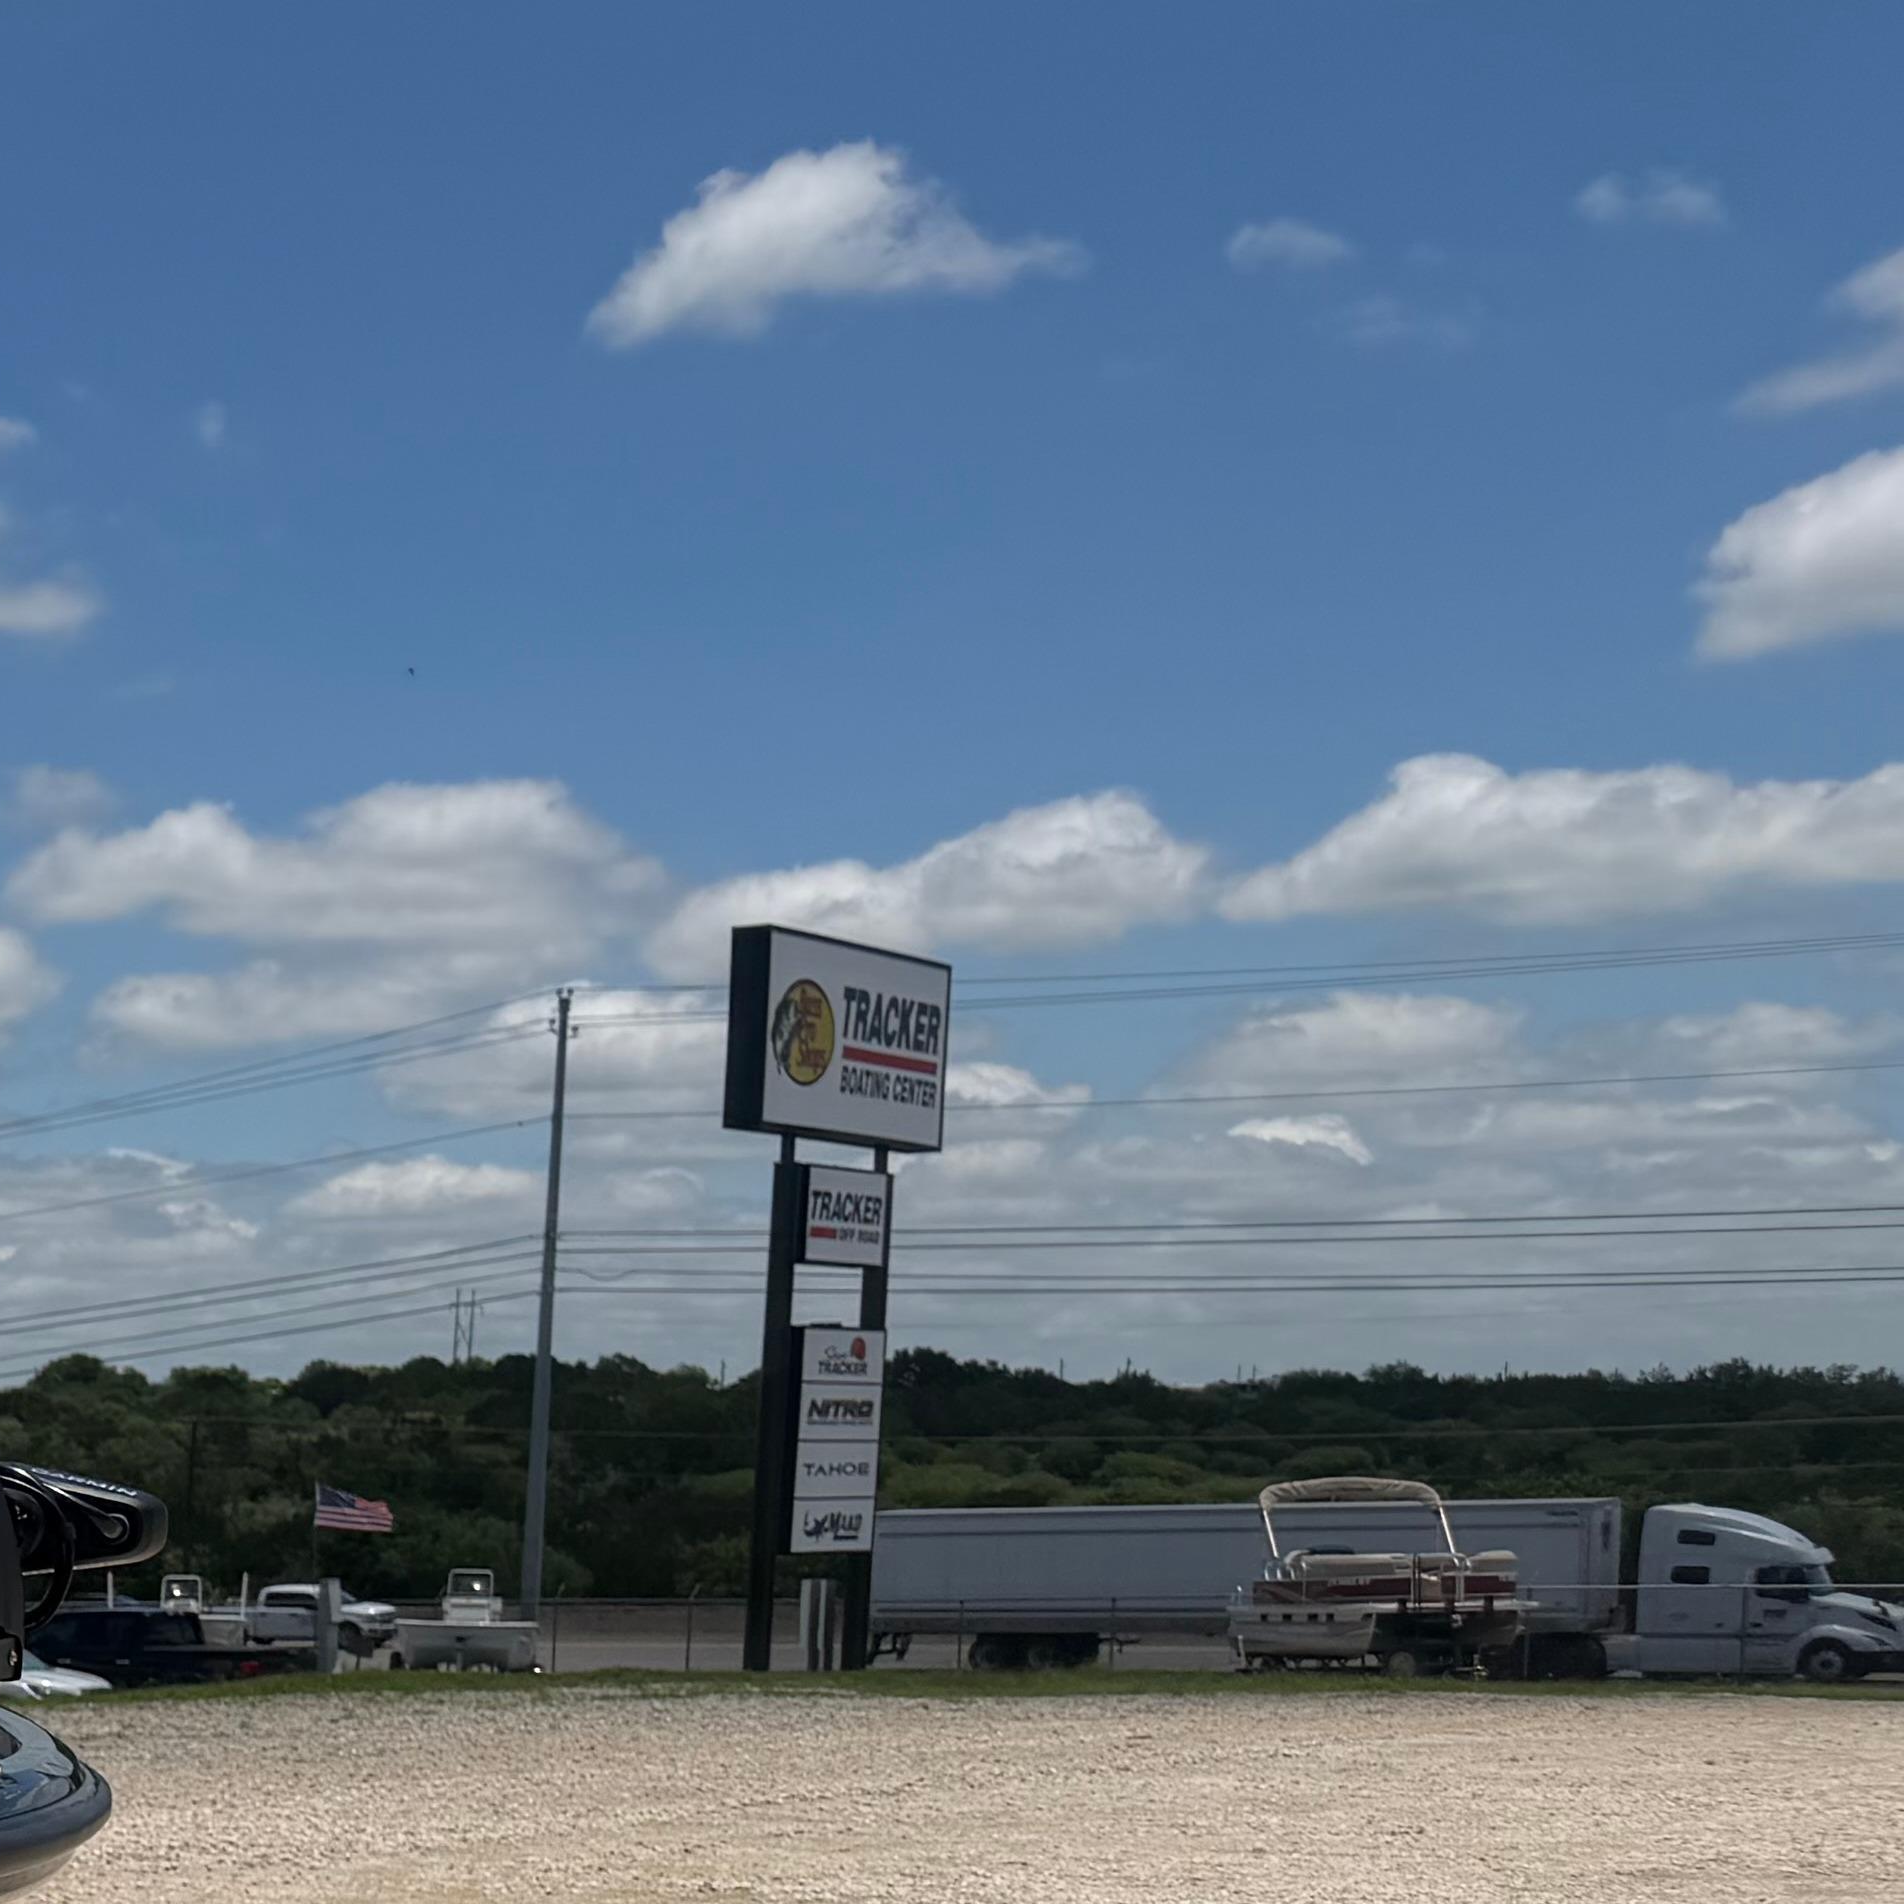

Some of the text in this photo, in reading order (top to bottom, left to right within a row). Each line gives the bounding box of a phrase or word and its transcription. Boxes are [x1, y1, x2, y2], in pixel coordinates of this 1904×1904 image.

[842, 986, 941, 1056] TRACKER
[840, 1066, 936, 1109] BOATING CENTER
[811, 1190, 882, 1226] TRACKER
[818, 1360, 867, 1376] TRACKER
[31, 1467, 138, 1497] GARMIN
[803, 1460, 869, 1477] TAHOE
